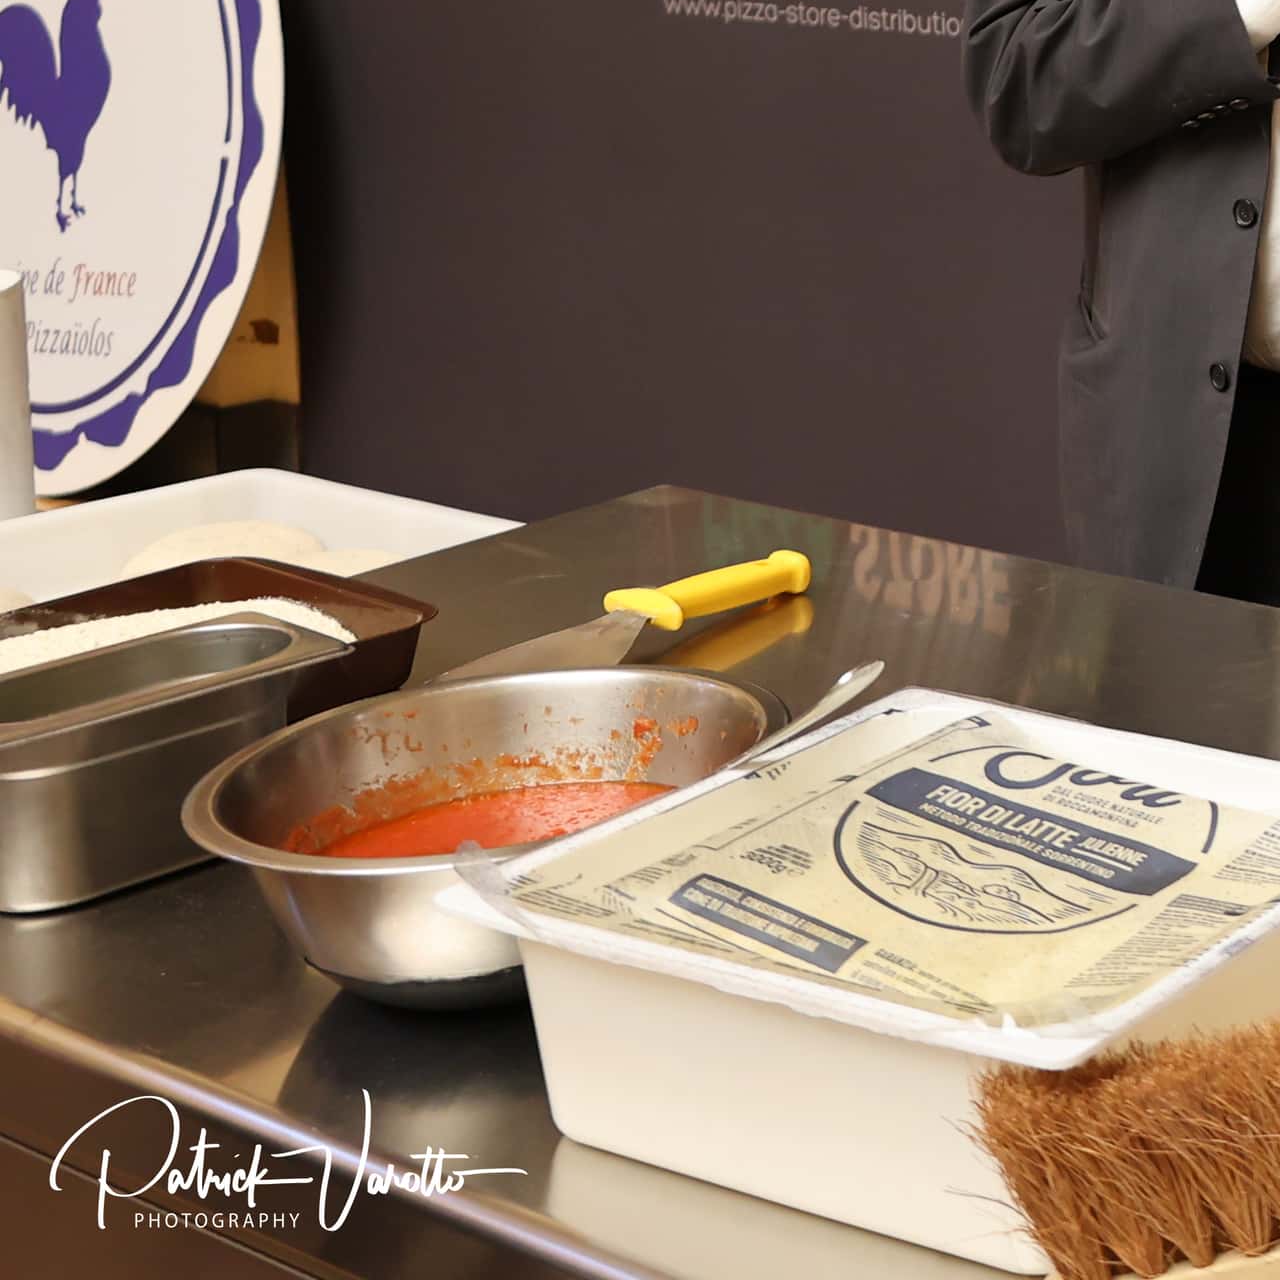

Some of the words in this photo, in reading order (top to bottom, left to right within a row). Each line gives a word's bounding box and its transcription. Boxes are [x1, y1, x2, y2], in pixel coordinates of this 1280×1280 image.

[44, 256, 65, 296] de
[67, 263, 137, 303] France
[925, 784, 986, 815] FIOR
[977, 805, 1006, 825] DI
[1003, 813, 1080, 848] LATTE
